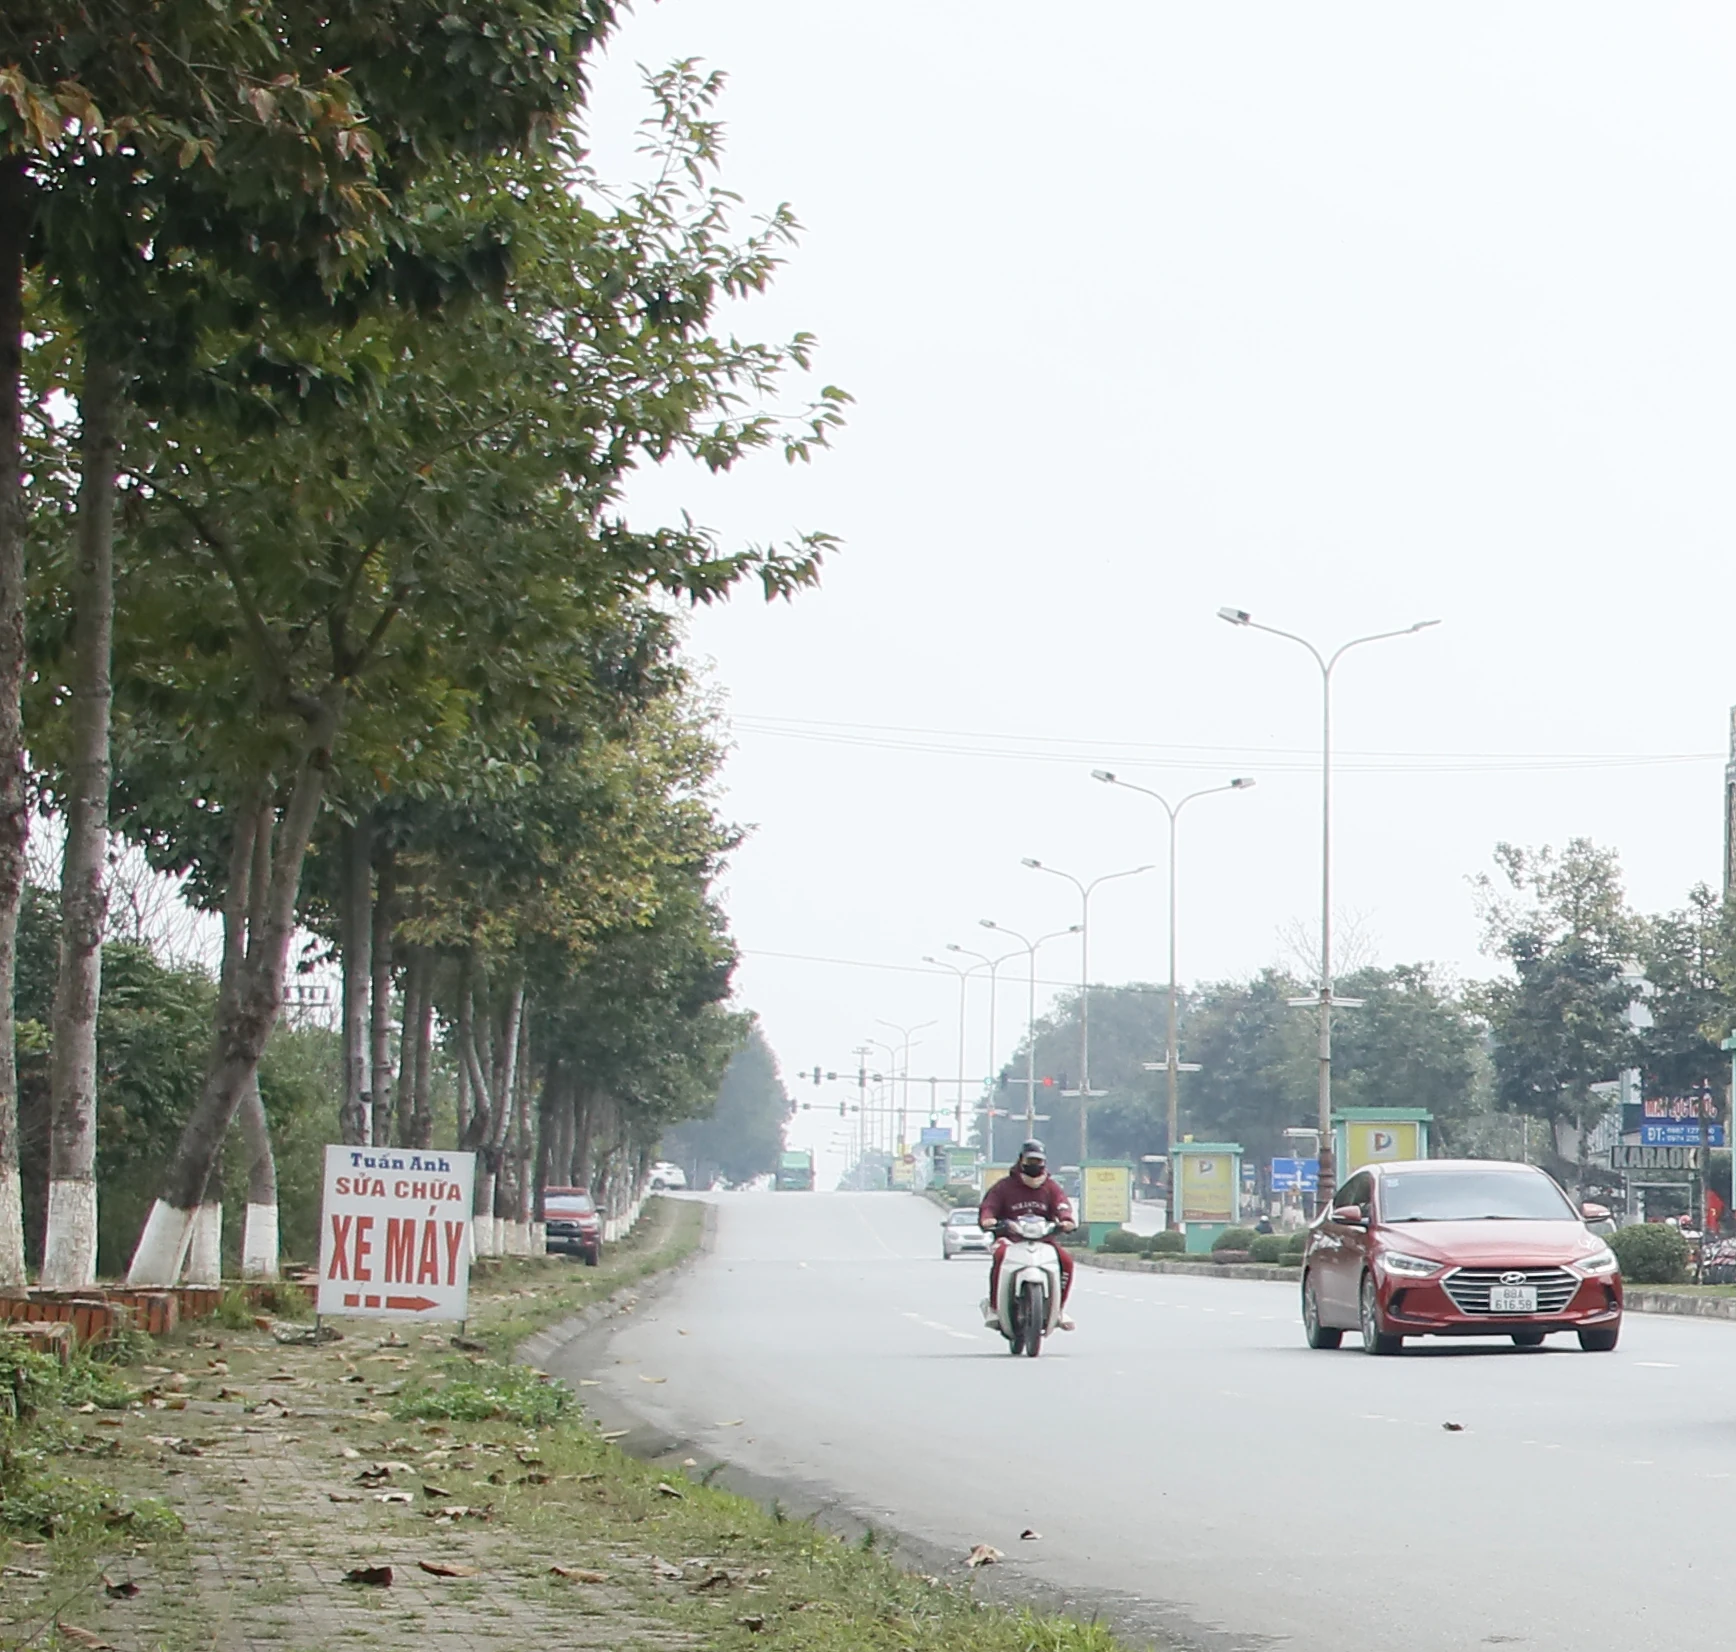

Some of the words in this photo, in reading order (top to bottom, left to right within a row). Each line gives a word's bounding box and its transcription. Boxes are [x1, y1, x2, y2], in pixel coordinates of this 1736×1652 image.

[350, 1152, 405, 1171] Tuấn
[409, 1155, 452, 1173] Anh
[335, 1170, 386, 1197] SỬA
[394, 1178, 463, 1202] CHỮA
[327, 1213, 374, 1282] XE
[384, 1204, 465, 1287] MÁY
